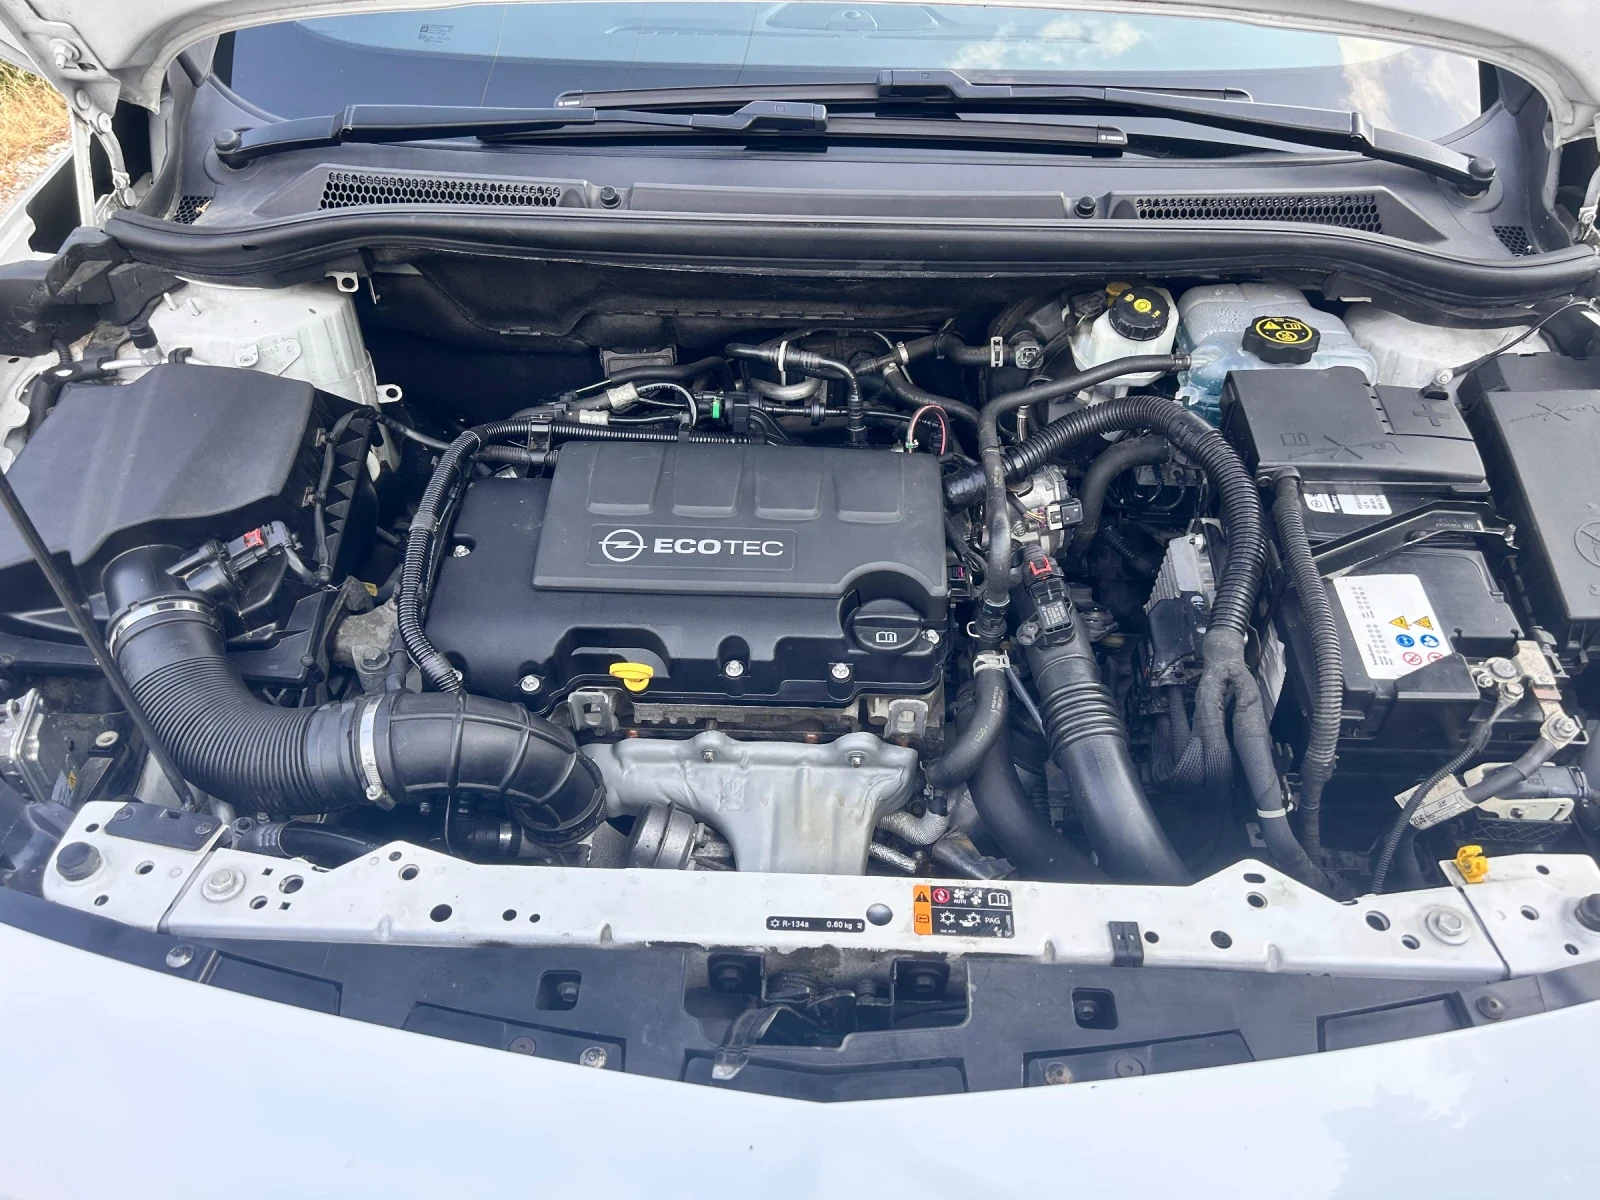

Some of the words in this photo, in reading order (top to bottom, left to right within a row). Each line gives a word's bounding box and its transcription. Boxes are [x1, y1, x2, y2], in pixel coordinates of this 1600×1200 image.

[653, 538, 784, 556] ECOTEC
[782, 920, 809, 928] R-134a
[826, 920, 843, 929] 0.60
[844, 922, 853, 930] kg
